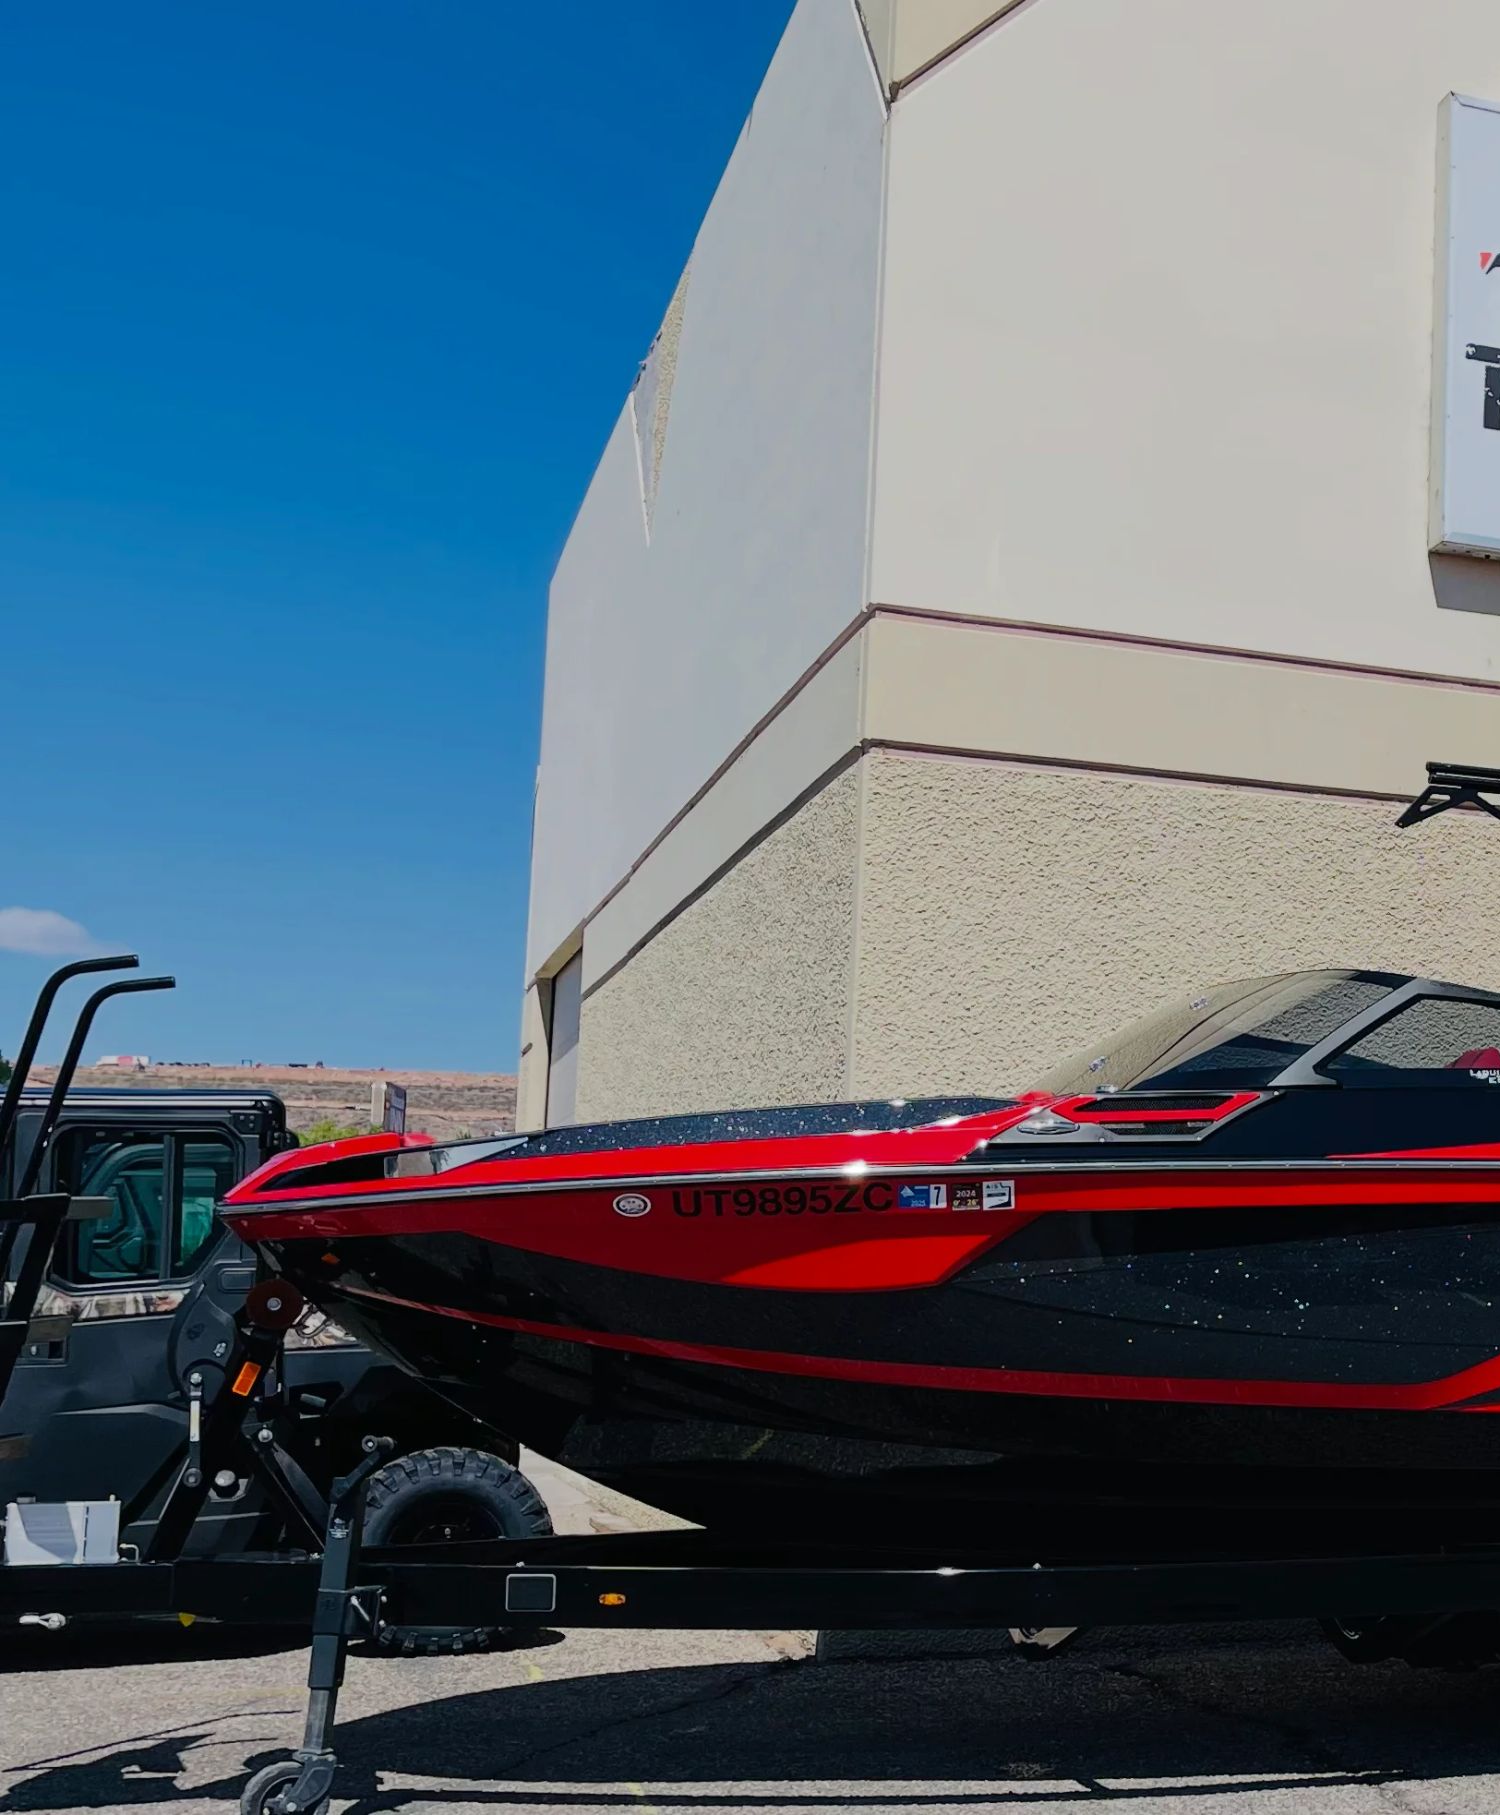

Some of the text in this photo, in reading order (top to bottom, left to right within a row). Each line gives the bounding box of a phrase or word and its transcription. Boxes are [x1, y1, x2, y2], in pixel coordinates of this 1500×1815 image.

[671, 1182, 893, 1218] UT9895ZC
[933, 1185, 942, 1206] 7
[956, 1189, 976, 1198] 2024
